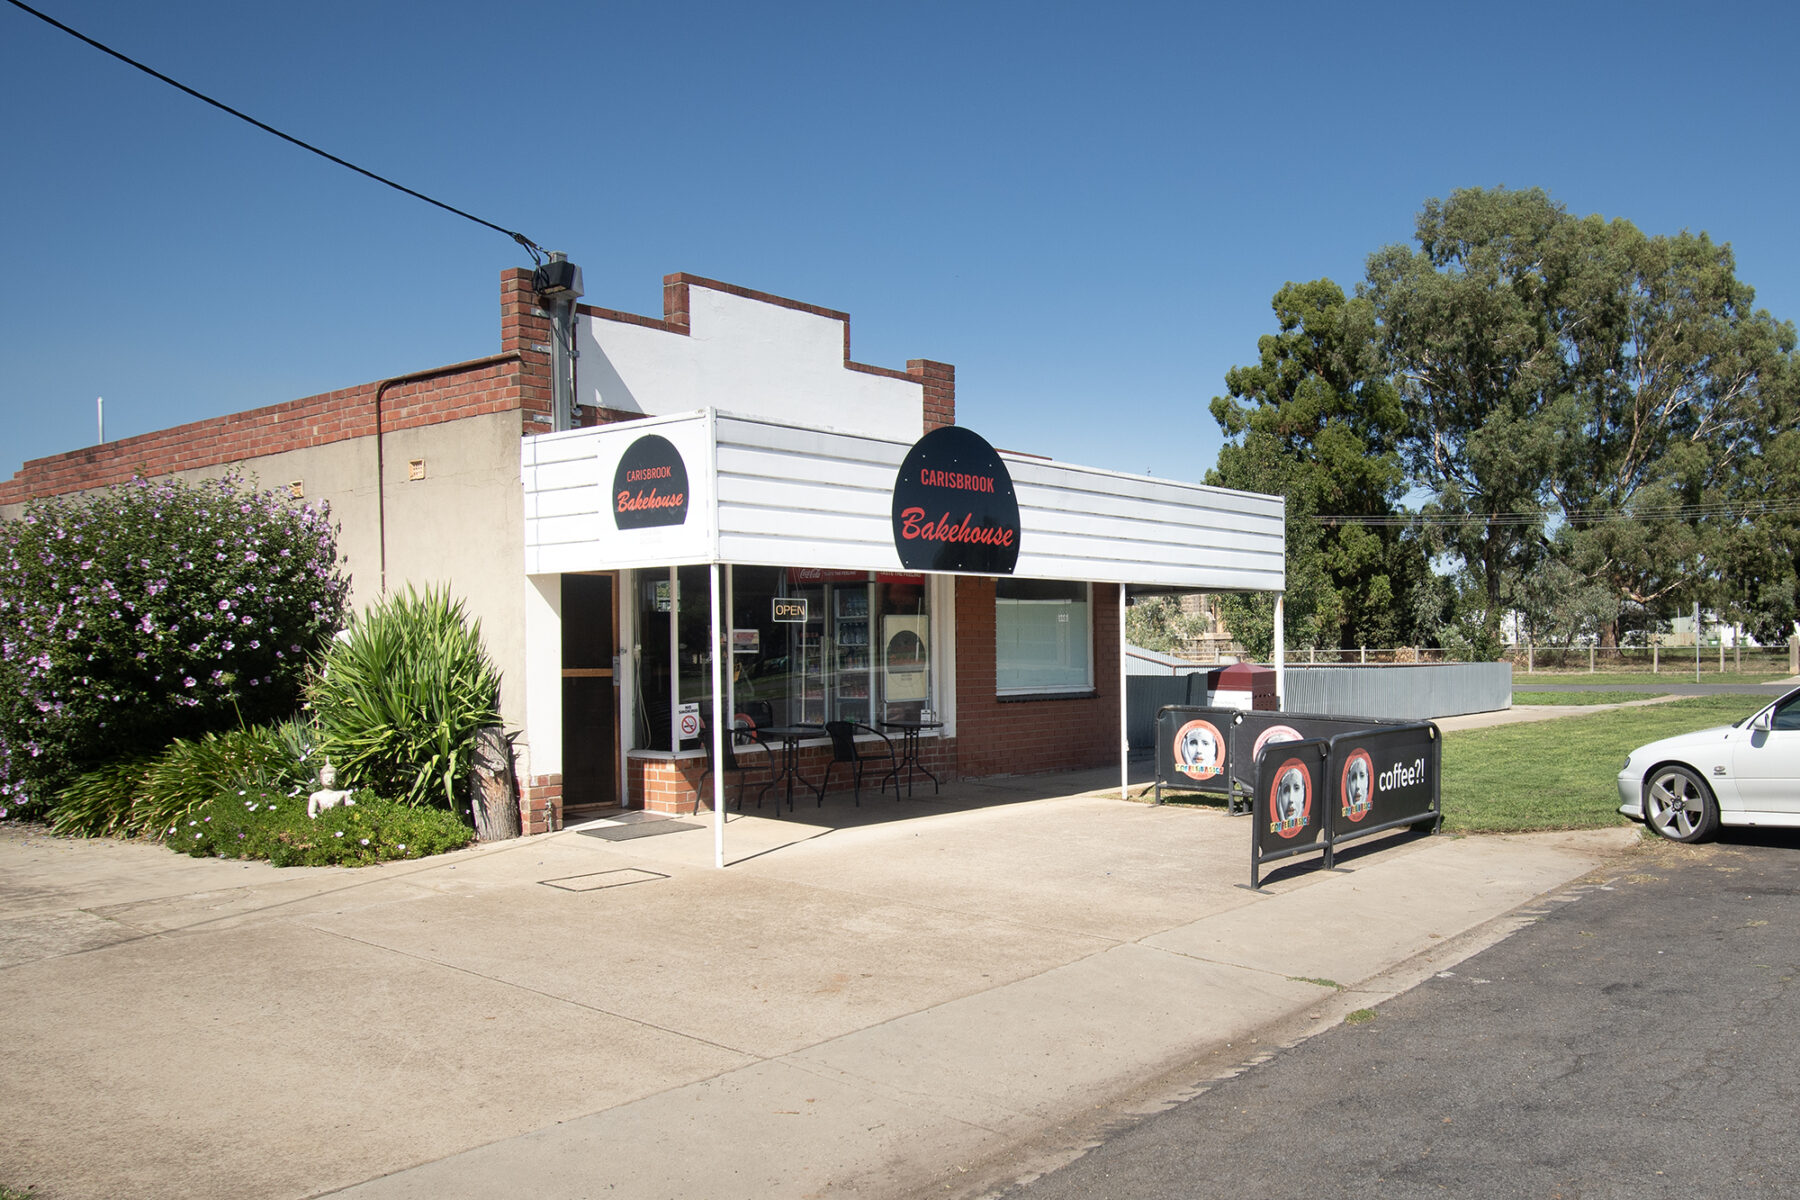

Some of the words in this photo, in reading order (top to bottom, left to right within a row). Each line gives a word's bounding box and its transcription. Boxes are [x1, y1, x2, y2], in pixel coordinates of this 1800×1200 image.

[626, 466, 672, 482] CARISBROOK
[921, 468, 994, 493] CARISBROOK
[617, 488, 684, 512] Bakehouse
[901, 506, 1013, 547] Bakehouse
[775, 605, 805, 616] OPEN
[1379, 758, 1425, 792] coffee?!
